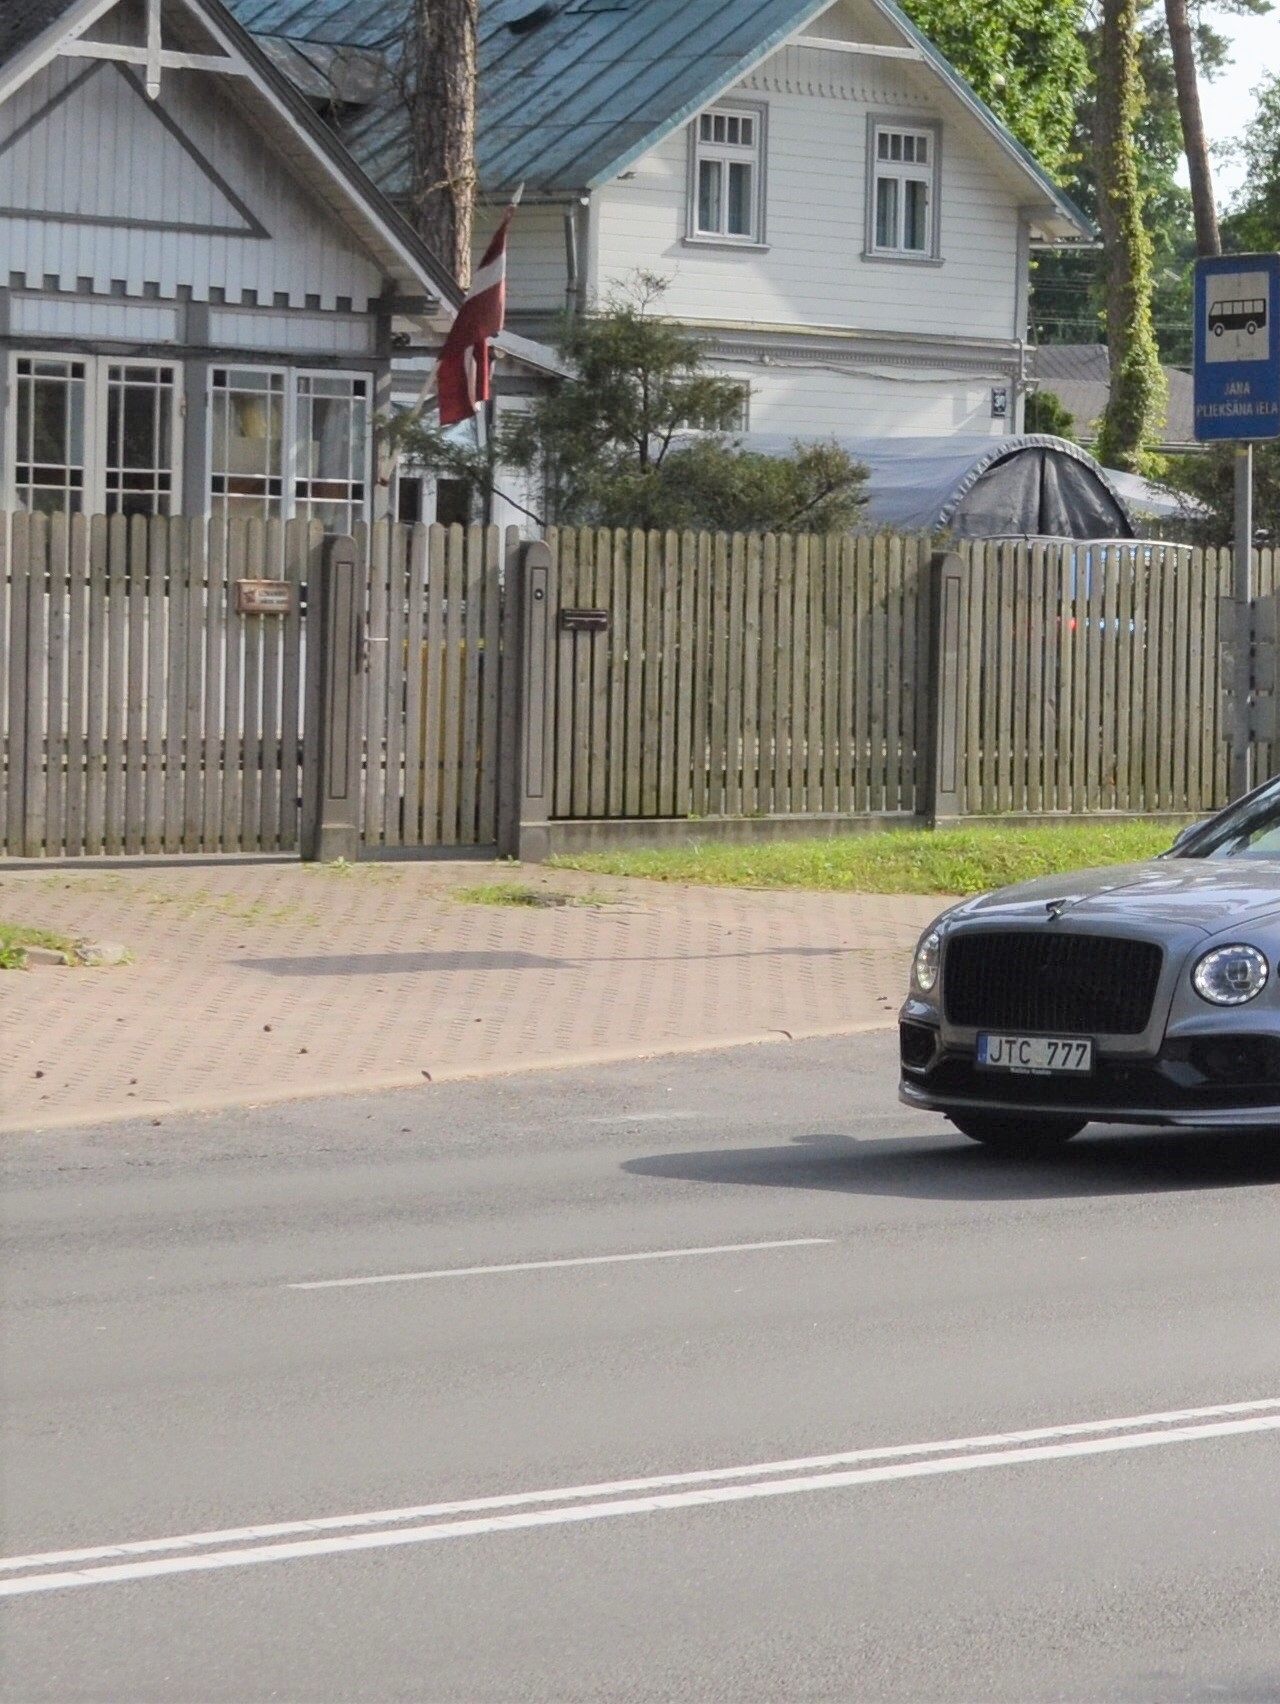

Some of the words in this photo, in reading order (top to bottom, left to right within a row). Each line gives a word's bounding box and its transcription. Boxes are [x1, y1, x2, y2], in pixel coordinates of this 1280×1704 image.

[1255, 401, 1278, 415] IELA
[990, 1039, 1031, 1064] JTC
[1047, 1041, 1088, 1067] 777
